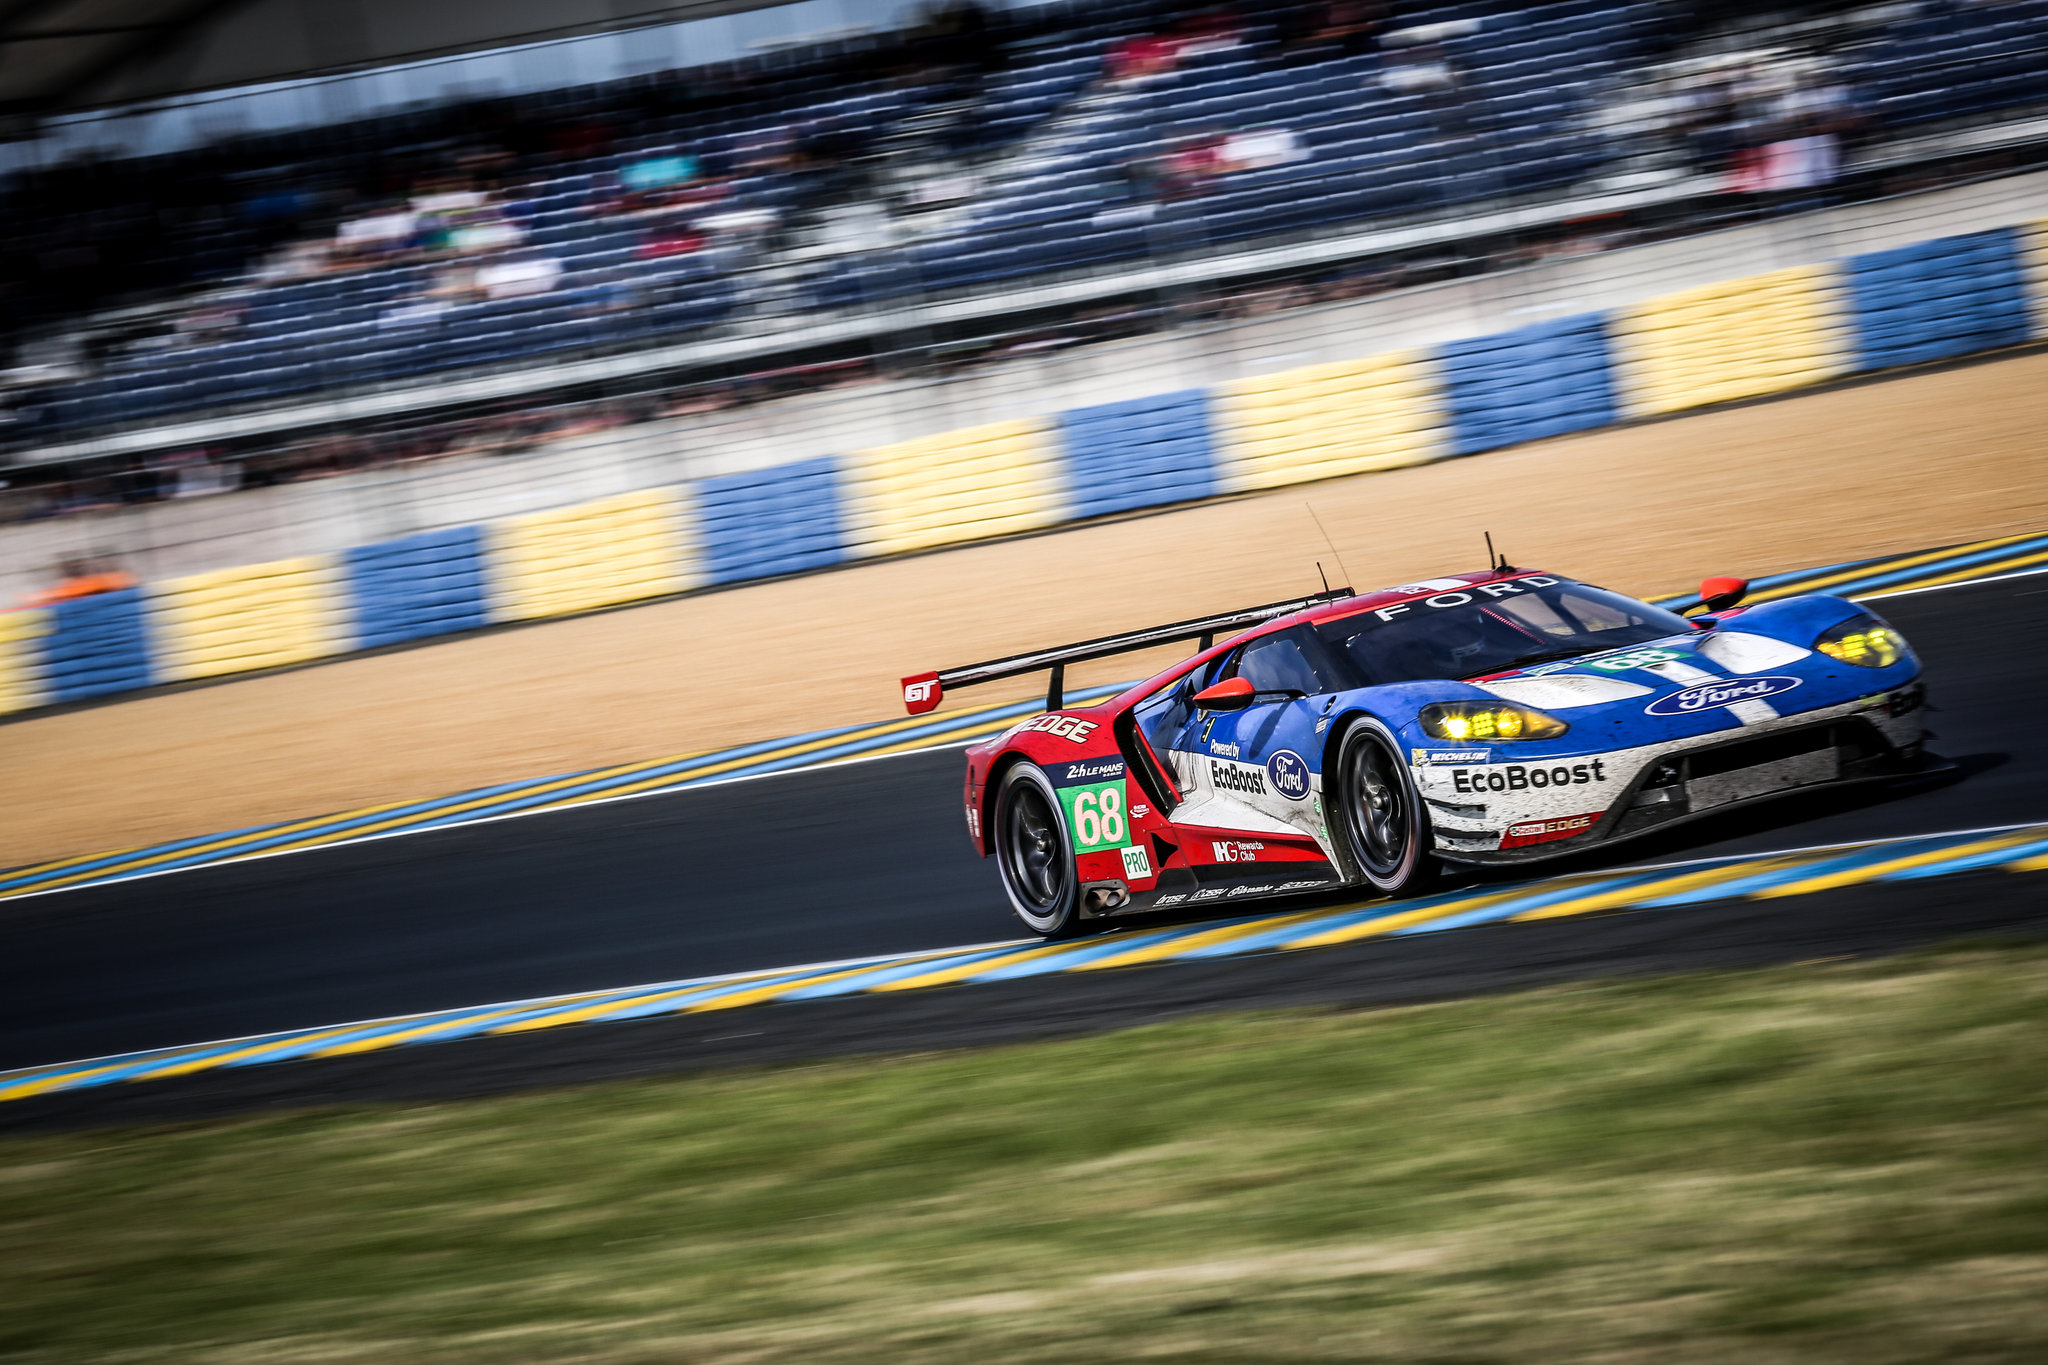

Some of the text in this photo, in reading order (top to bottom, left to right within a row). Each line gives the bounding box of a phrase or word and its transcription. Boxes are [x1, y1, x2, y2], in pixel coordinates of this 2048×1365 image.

[1374, 576, 1559, 622] FORD
[1591, 649, 1681, 670] 68
[904, 679, 939, 702] GT
[1677, 680, 1775, 710] Ford
[1021, 714, 1099, 744] EDGE
[1210, 738, 1240, 760] Powered by
[1431, 751, 1488, 761] MICHELIN
[1086, 766, 1099, 776] LE
[1099, 762, 1124, 774] MANS
[1211, 759, 1267, 795] EcoBoost
[1275, 755, 1304, 791] Ford
[1453, 758, 1605, 793] EcoBoost
[1074, 788, 1124, 846] 68
[1518, 815, 1592, 836] Castrol EDGE
[1124, 851, 1148, 874] PRO
[1212, 841, 1265, 862] IHG Rewards
[1240, 850, 1256, 861] Club
